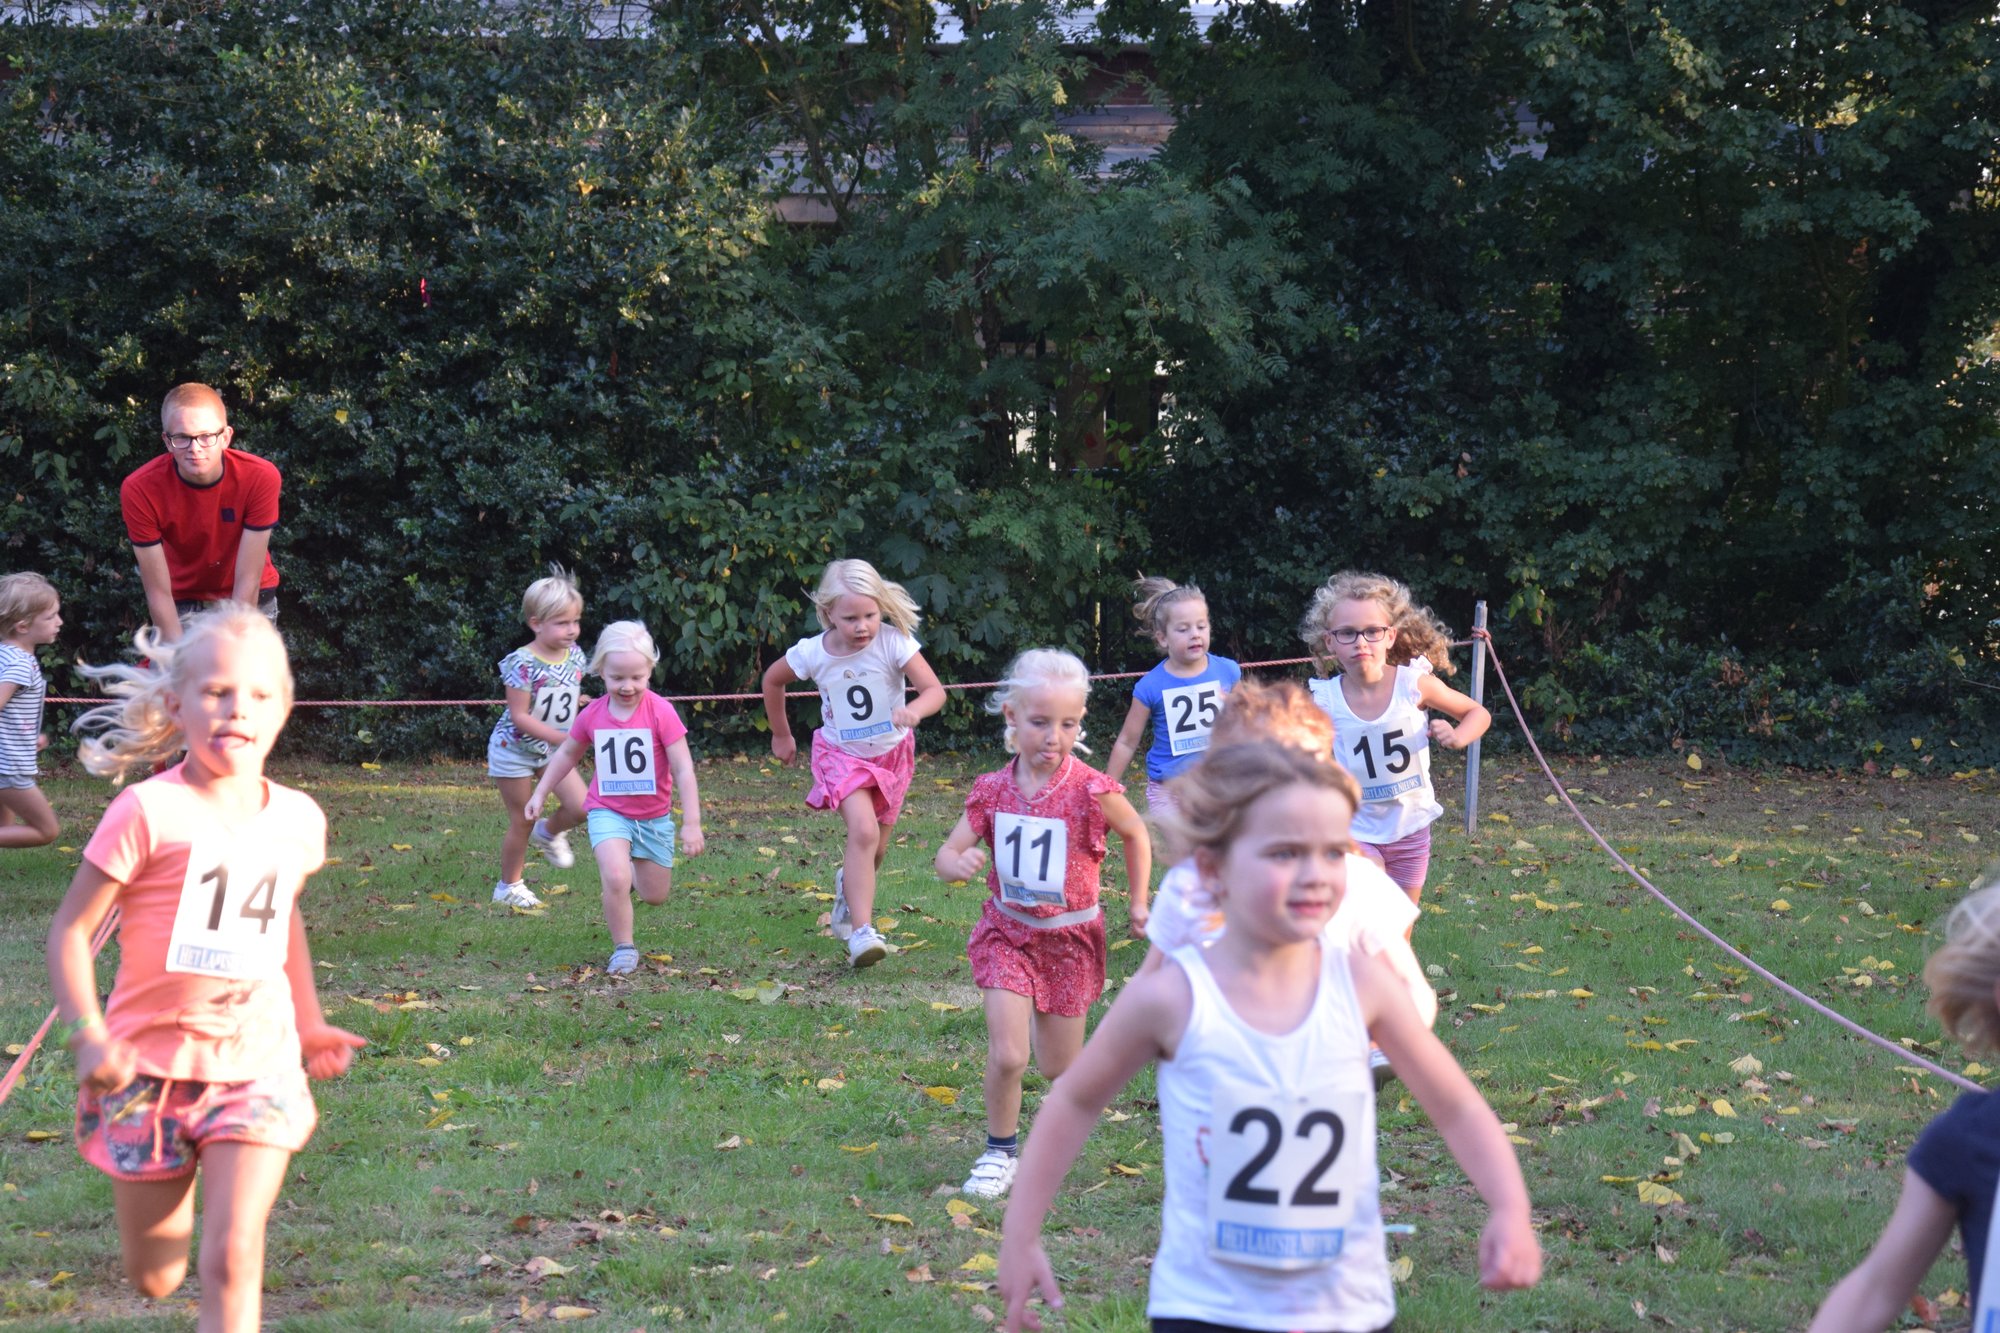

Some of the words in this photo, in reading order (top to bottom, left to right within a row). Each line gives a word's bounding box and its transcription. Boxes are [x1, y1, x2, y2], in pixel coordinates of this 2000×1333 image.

[541, 692, 571, 723] 13
[847, 685, 873, 721] 9
[1172, 690, 1220, 733] 25
[601, 737, 646, 774] 16
[1353, 728, 1411, 779] 15
[1005, 825, 1052, 881] 11
[200, 862, 277, 934] 14
[1224, 1107, 1345, 1206] 22
